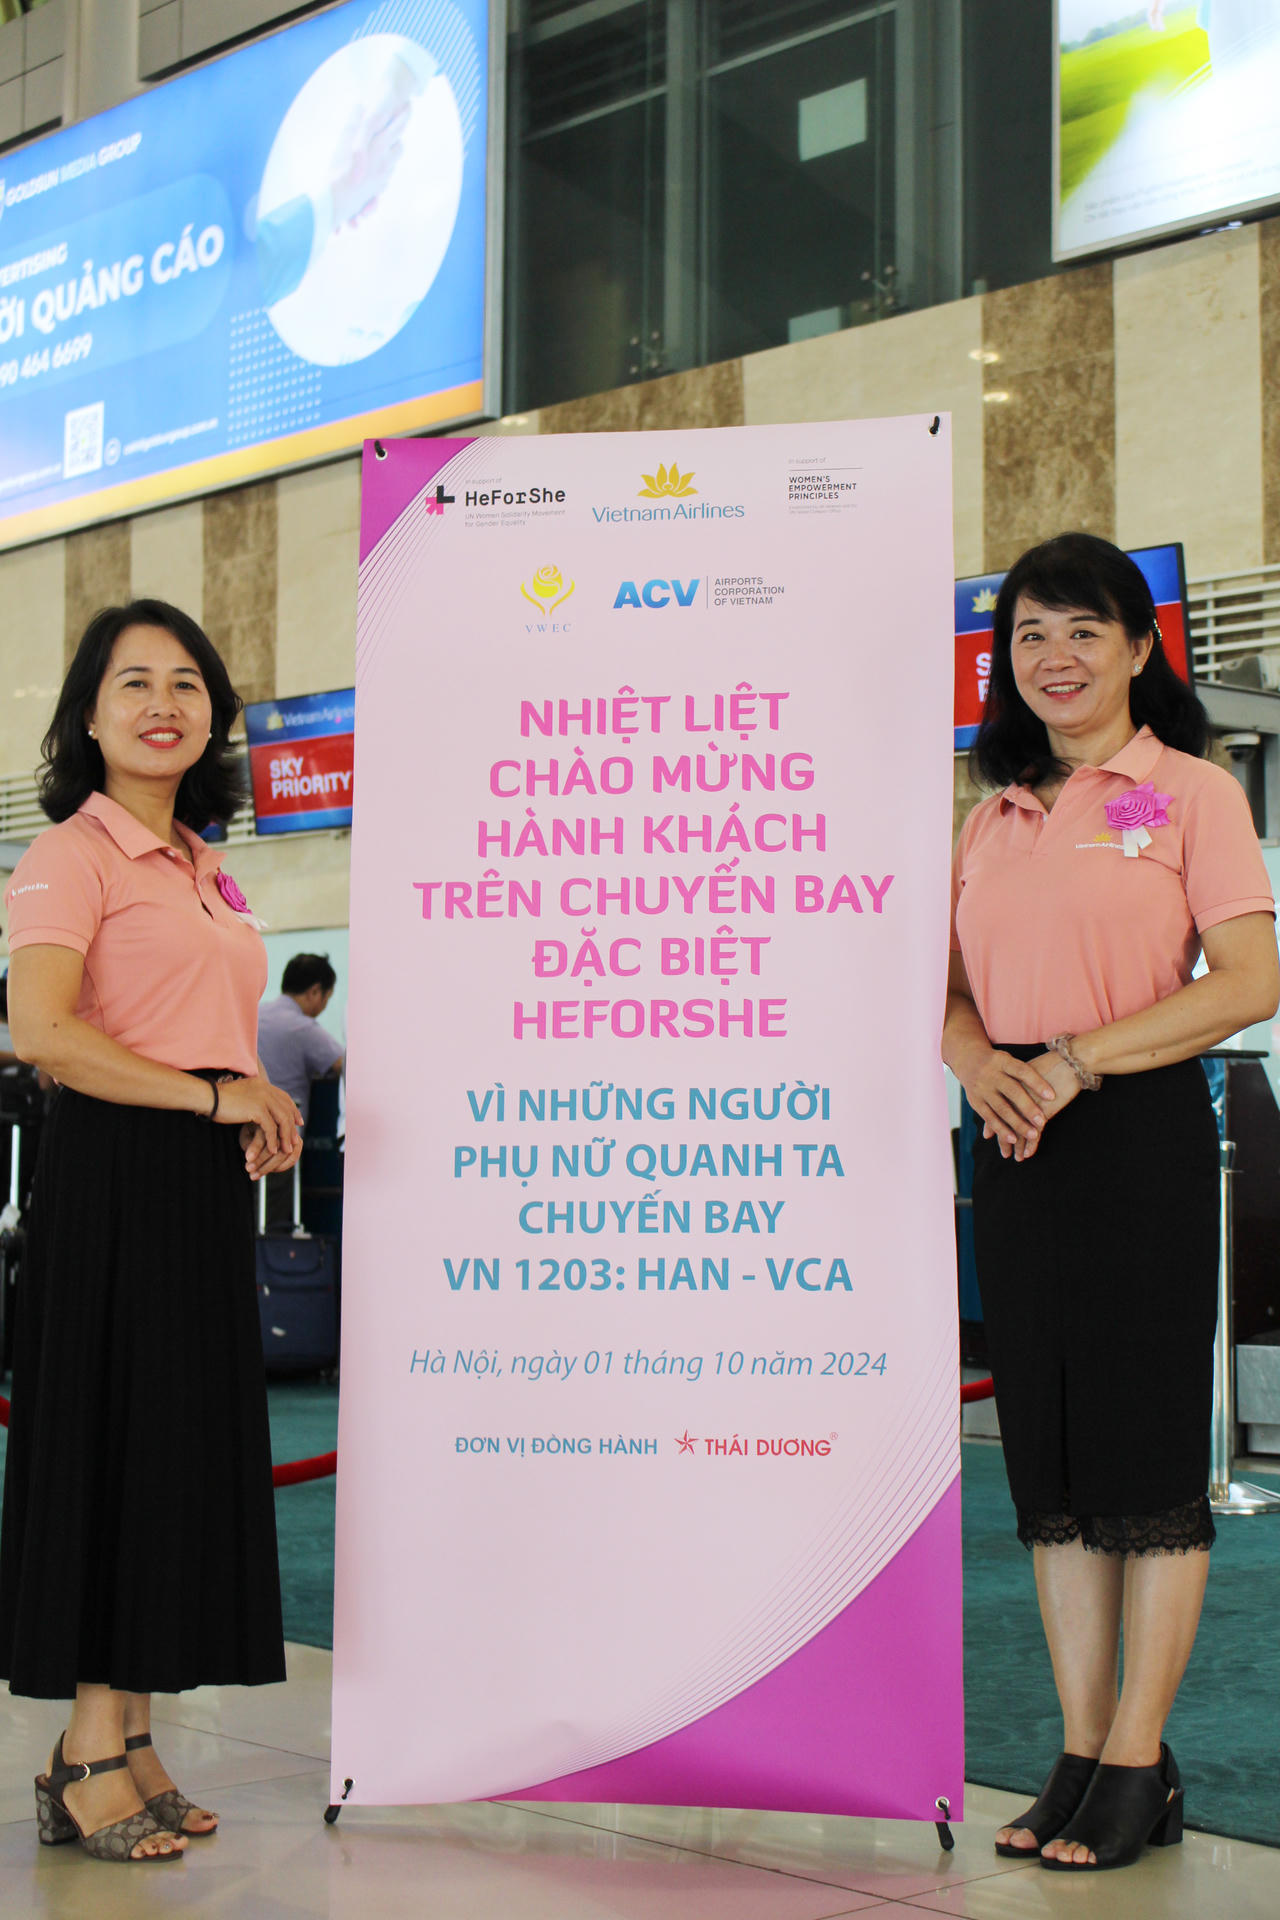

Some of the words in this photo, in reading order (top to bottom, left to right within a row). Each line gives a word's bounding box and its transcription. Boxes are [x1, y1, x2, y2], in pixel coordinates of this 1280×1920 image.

[97, 132, 142, 166] GROUP
[31, 258, 144, 334] QUẢNG
[150, 222, 225, 284] CÁO
[788, 475, 831, 483] WOMEN'S
[788, 482, 857, 492] EMPOWERMENT
[788, 491, 840, 500] PRINCIPLES
[465, 487, 566, 507] HeForShe
[613, 578, 701, 609] ACV
[714, 576, 764, 586] AIRPORTS
[714, 586, 785, 596] CORPORATION
[714, 598, 728, 606] OF
[730, 596, 773, 606] VIETNAM
[520, 685, 671, 744] NHIỆT
[685, 681, 790, 741] LIỆT
[270, 756, 304, 779] SKY
[490, 746, 633, 798] CHÀO
[653, 741, 815, 793] MỪNG
[271, 771, 352, 800] PRIORITY
[478, 808, 624, 858] HÀNH
[643, 802, 826, 854] KHÁCH
[412, 868, 541, 920] TRÊN
[560, 856, 775, 917] CHUYẾN
[795, 874, 895, 914] BAY
[531, 928, 642, 987] ĐẶC
[661, 925, 771, 986] BIỆT
[513, 998, 788, 1040] HEFORSHE
[467, 1083, 506, 1122] VÌ
[520, 1081, 675, 1122] NHỮNG
[689, 1081, 830, 1120] NGƯỜI
[454, 1145, 538, 1188] PHỤ
[552, 1137, 616, 1179] NỮ
[626, 1144, 782, 1182] QUANH
[793, 1144, 845, 1178] TA
[519, 1190, 691, 1235] CHUYẾN
[704, 1201, 786, 1234] BAY
[443, 1258, 500, 1291] VN
[516, 1259, 626, 1291] 1203:
[638, 1257, 730, 1291] HAN
[766, 1258, 854, 1292] VCA
[410, 1349, 446, 1376] Hà
[454, 1350, 502, 1380] Nội,
[512, 1350, 578, 1381] ngày
[585, 1352, 613, 1375] 01
[624, 1350, 704, 1382] tháng
[716, 1352, 744, 1376] 10
[752, 1352, 813, 1376] năm
[821, 1352, 888, 1377] 2024
[455, 1437, 500, 1454] ĐƠN
[506, 1437, 526, 1458] VỊ
[600, 1434, 658, 1456] HÀNH
[705, 1433, 748, 1456] THÁI
[757, 1438, 831, 1456] DƯƠNG
